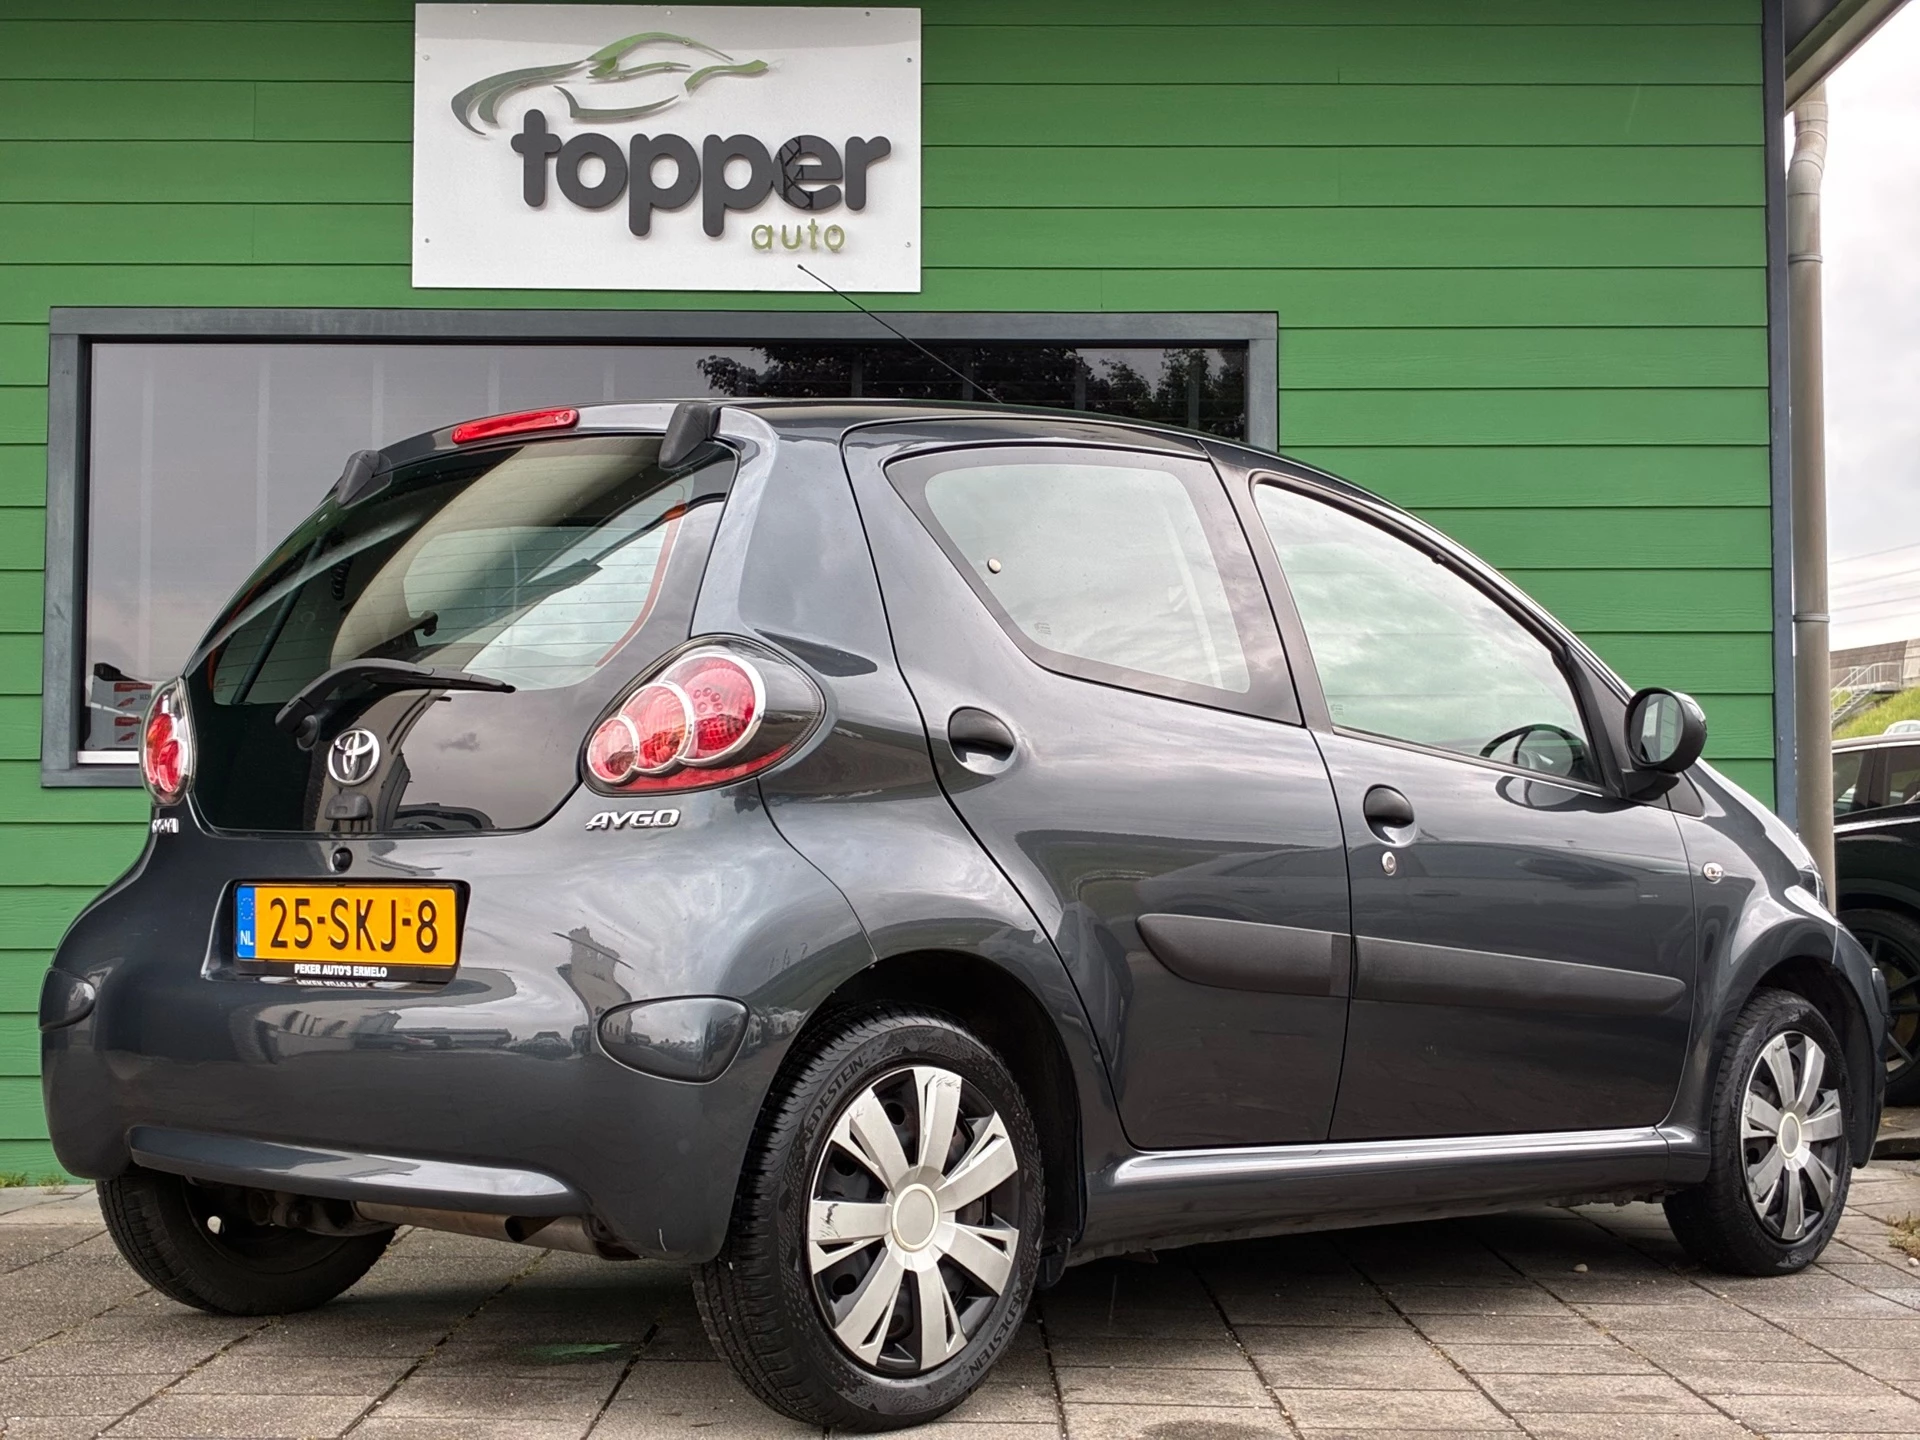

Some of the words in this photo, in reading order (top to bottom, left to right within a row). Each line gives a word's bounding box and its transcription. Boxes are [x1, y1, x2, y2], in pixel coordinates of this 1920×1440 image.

[510, 108, 892, 238] topper
[750, 217, 846, 253] auto
[585, 808, 681, 831] AYGO
[240, 929, 254, 946] NL
[269, 897, 438, 954] 25-SKJ-8
[294, 963, 321, 975] PEKER
[322, 964, 352, 977] AUTO'S
[353, 965, 388, 978] ERMELO
